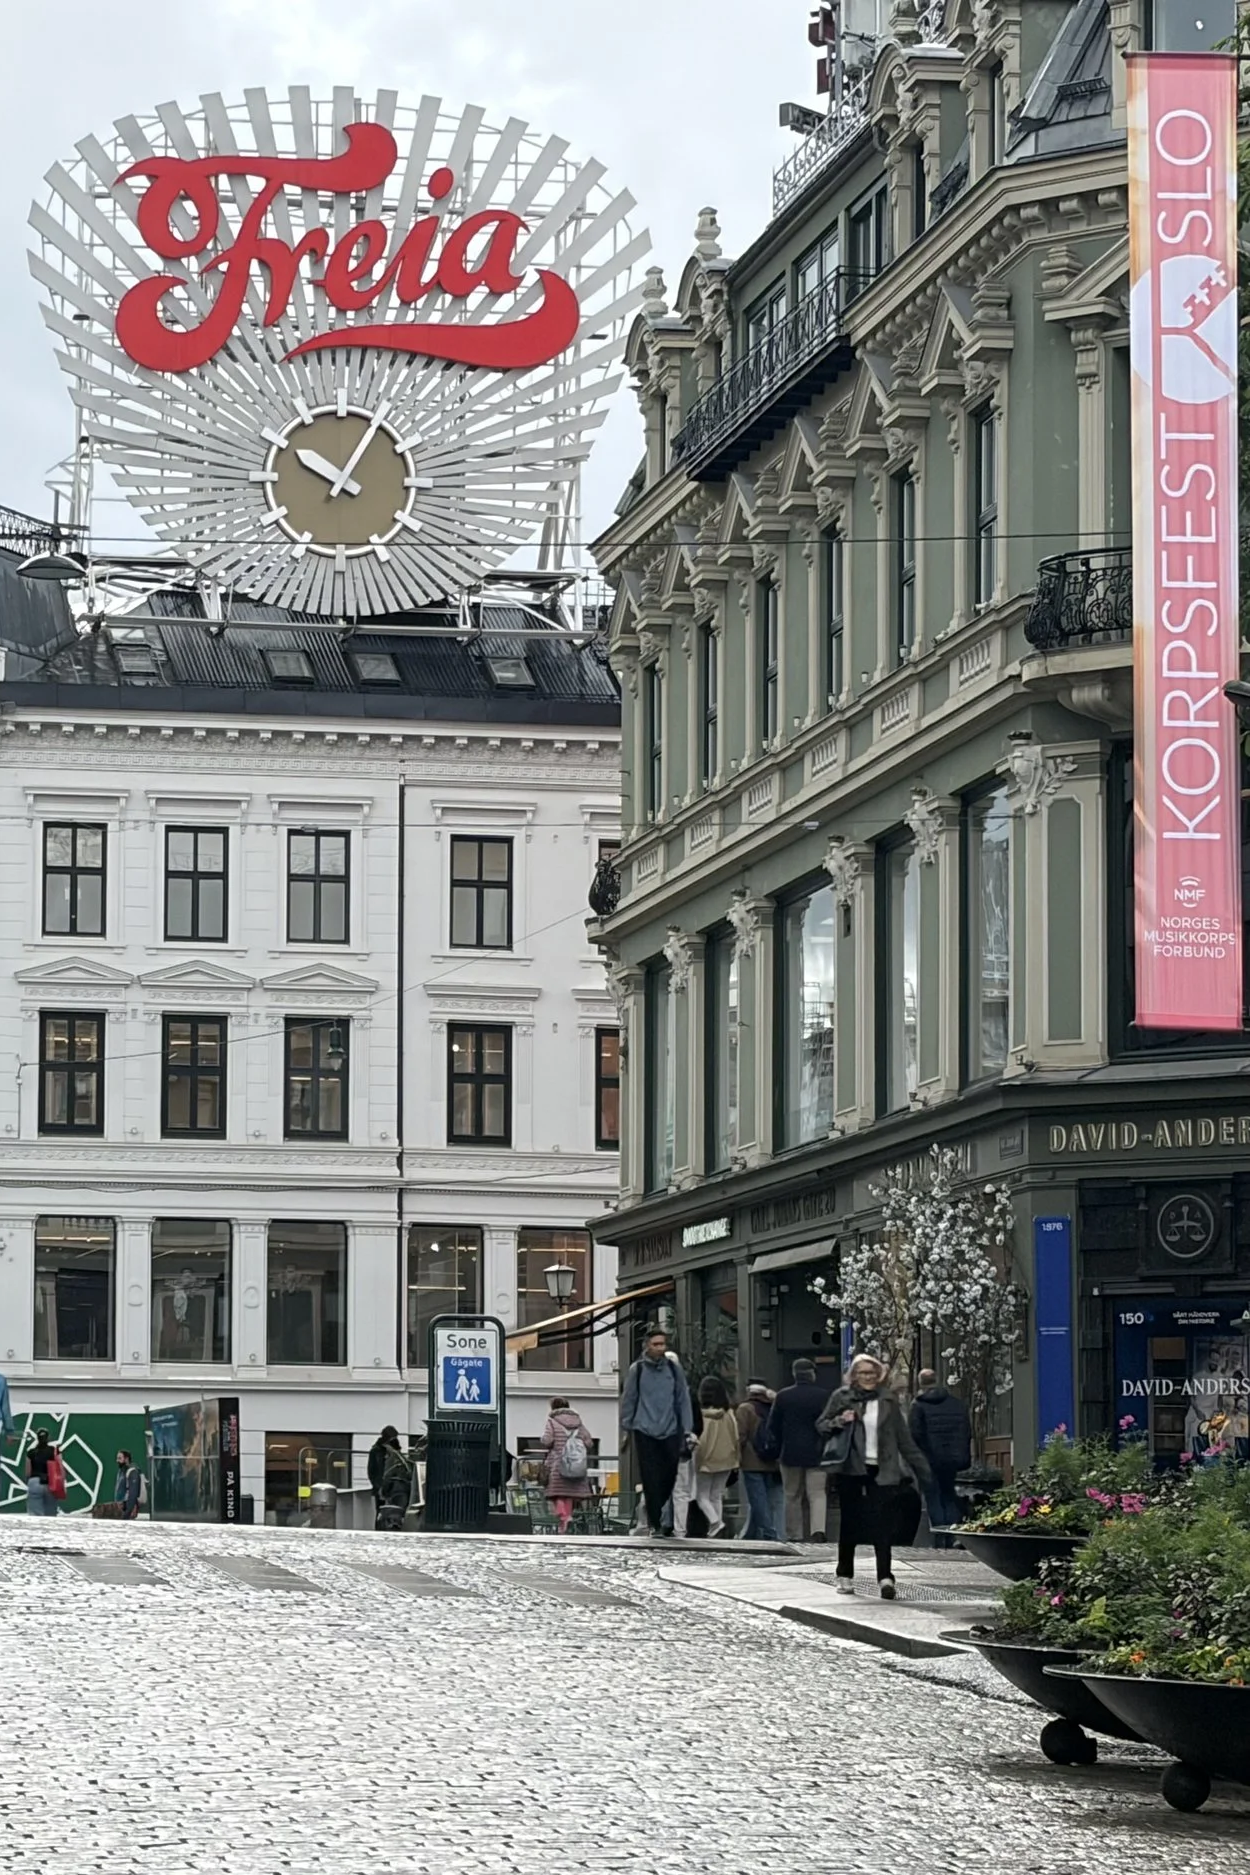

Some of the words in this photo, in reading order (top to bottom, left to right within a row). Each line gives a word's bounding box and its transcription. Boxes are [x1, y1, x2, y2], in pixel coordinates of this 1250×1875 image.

[113, 122, 580, 373] Freia
[1160, 412, 1221, 840] KORPSFEST
[1174, 887, 1206, 902] NMF
[1160, 916, 1221, 930] NORGES
[1144, 930, 1237, 945] MUSIKKORPS
[1153, 944, 1226, 960] FORBUND
[1119, 1312, 1144, 1325] 150
[446, 1333, 487, 1349] Sone
[450, 1358, 483, 1368] Gågate
[227, 1489, 235, 1518] KINO
